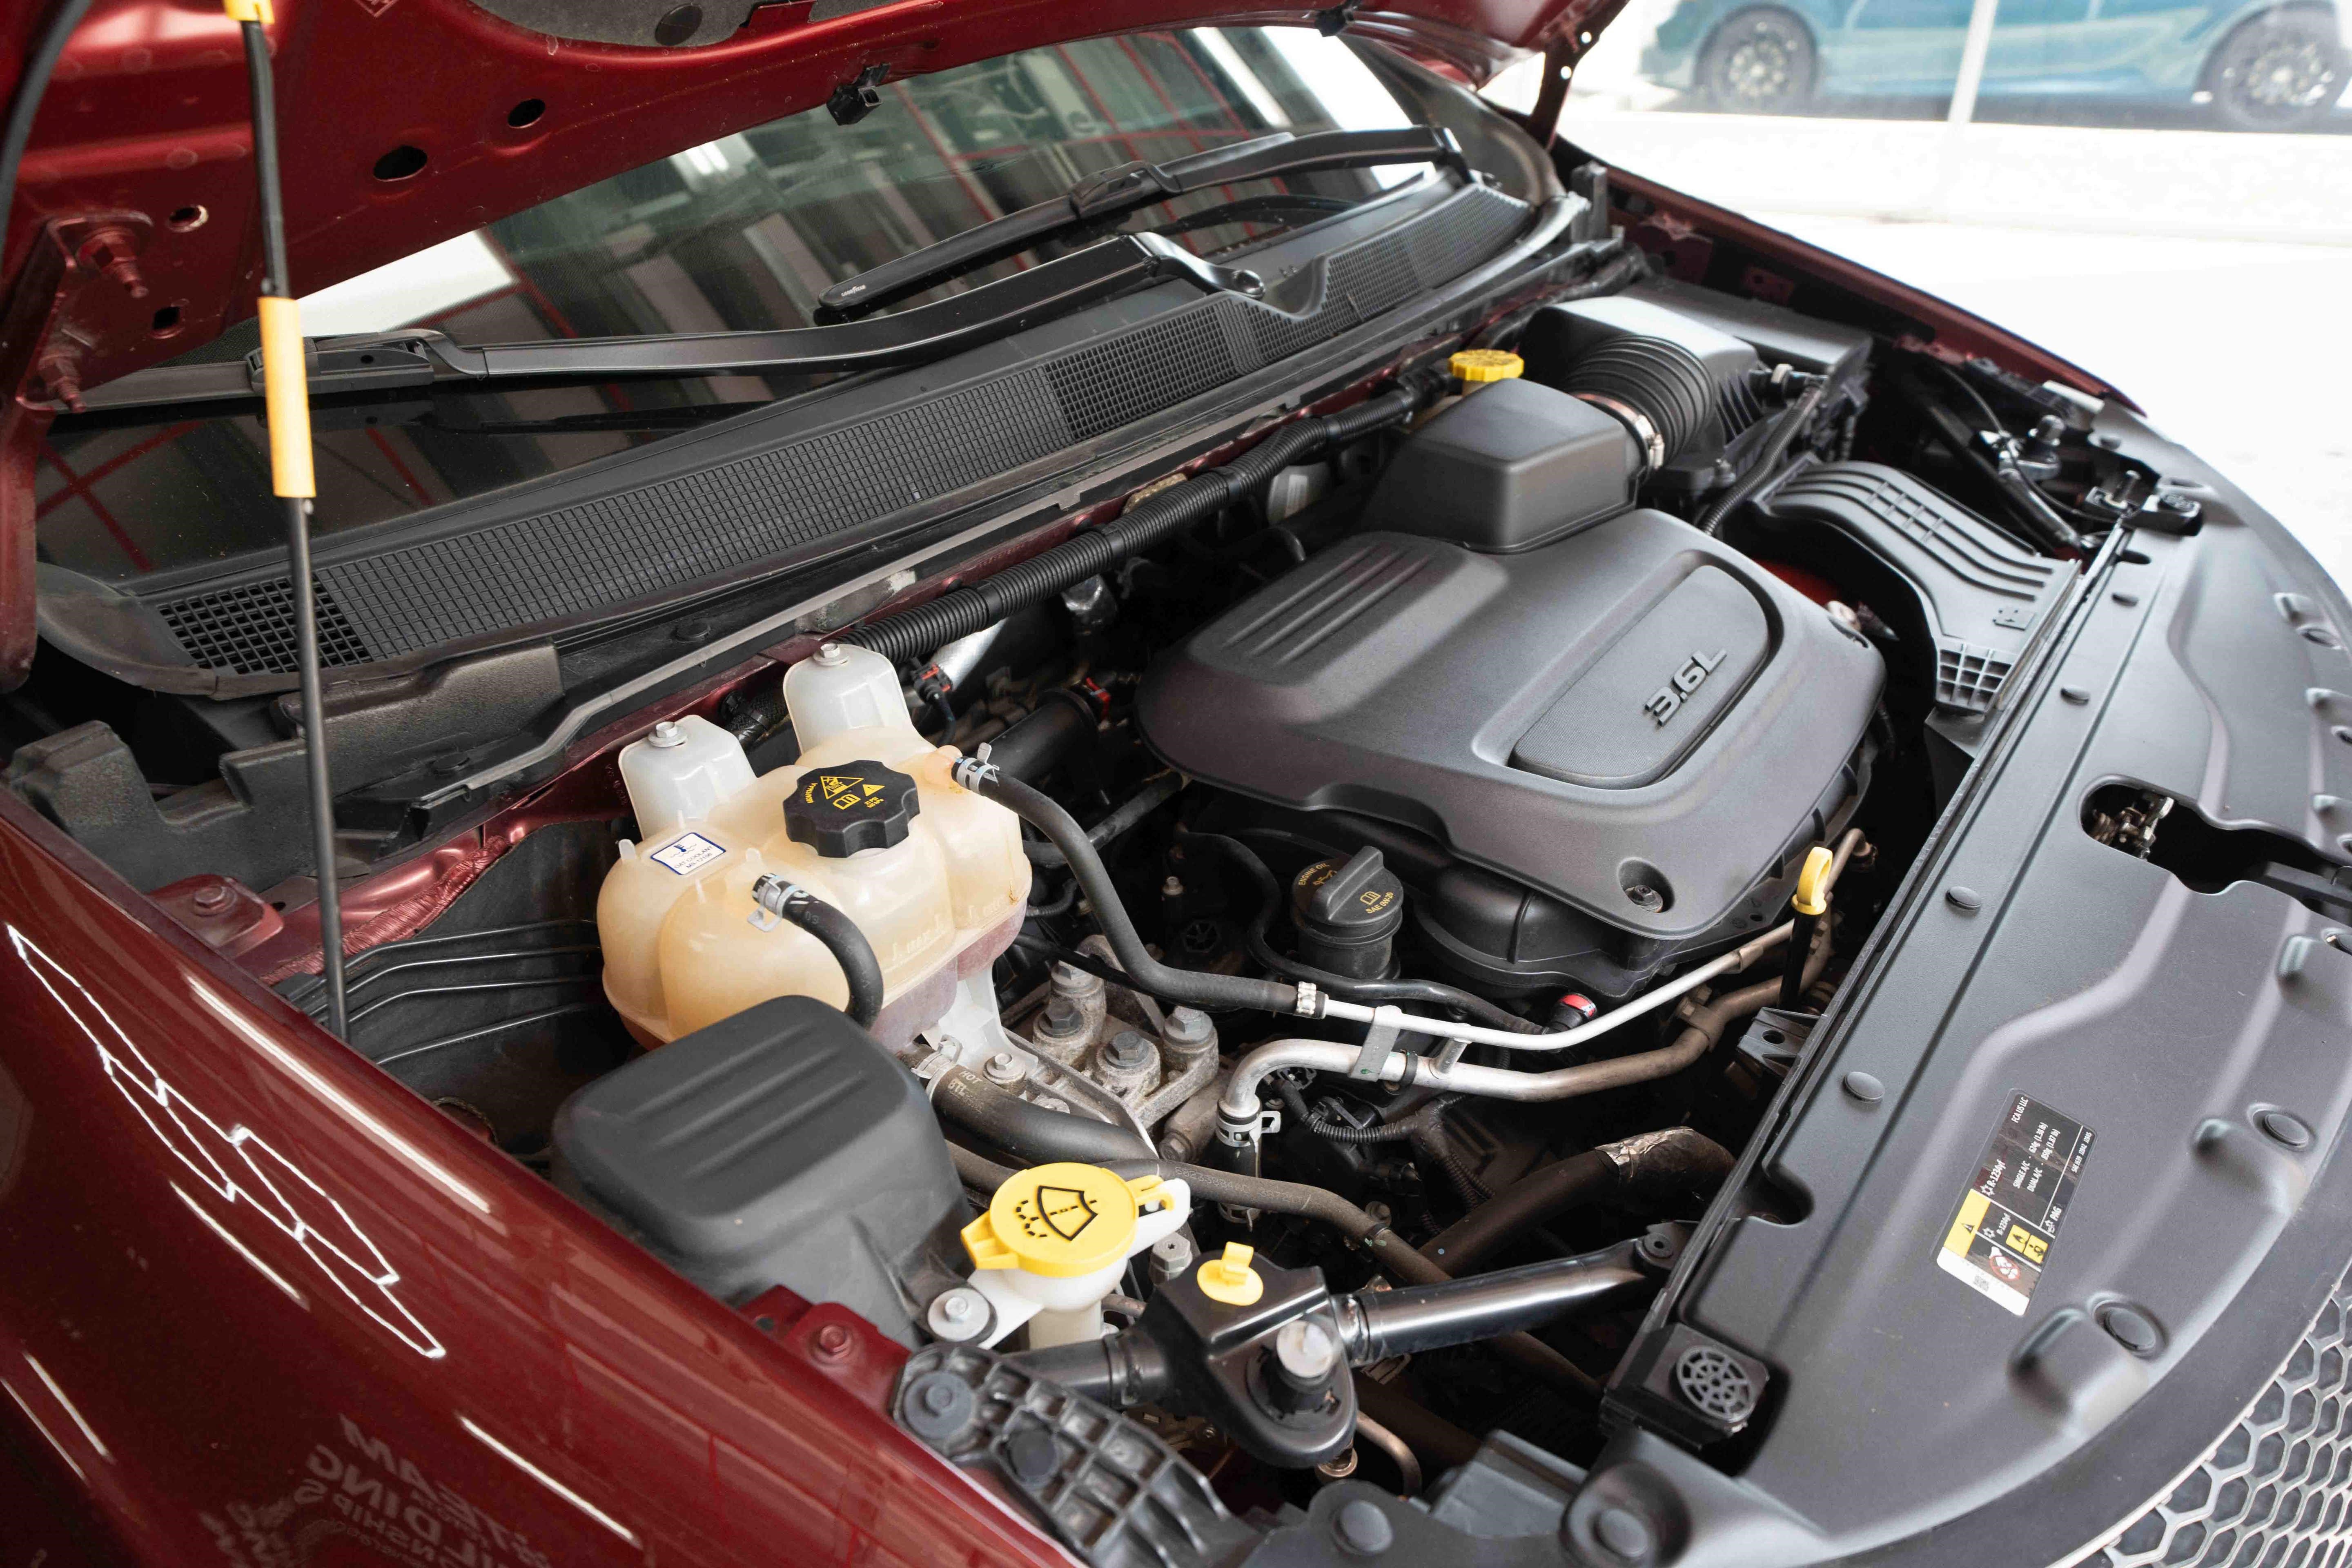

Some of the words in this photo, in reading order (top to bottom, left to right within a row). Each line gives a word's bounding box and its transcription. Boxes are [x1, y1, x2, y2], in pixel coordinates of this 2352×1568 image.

[1645, 649, 1727, 726] 3.6L
[686, 846, 713, 862] COOLANT
[1298, 867, 1316, 886] ENGINE
[1365, 904, 1383, 914] SAE
[1379, 892, 1394, 906] 0W-20
[959, 1070, 983, 1084] HOT
[2011, 1111, 2021, 1123] FCA
[2016, 1103, 2025, 1114] US
[1987, 1159, 2006, 1188] R-1234yf
[2013, 1169, 2026, 1189] SINGLE
[2021, 1160, 2030, 1171] A/C
[2027, 1177, 2039, 1192] DUAL
[2033, 1167, 2043, 1178] A/C
[2049, 1206, 2062, 1221] PAG
